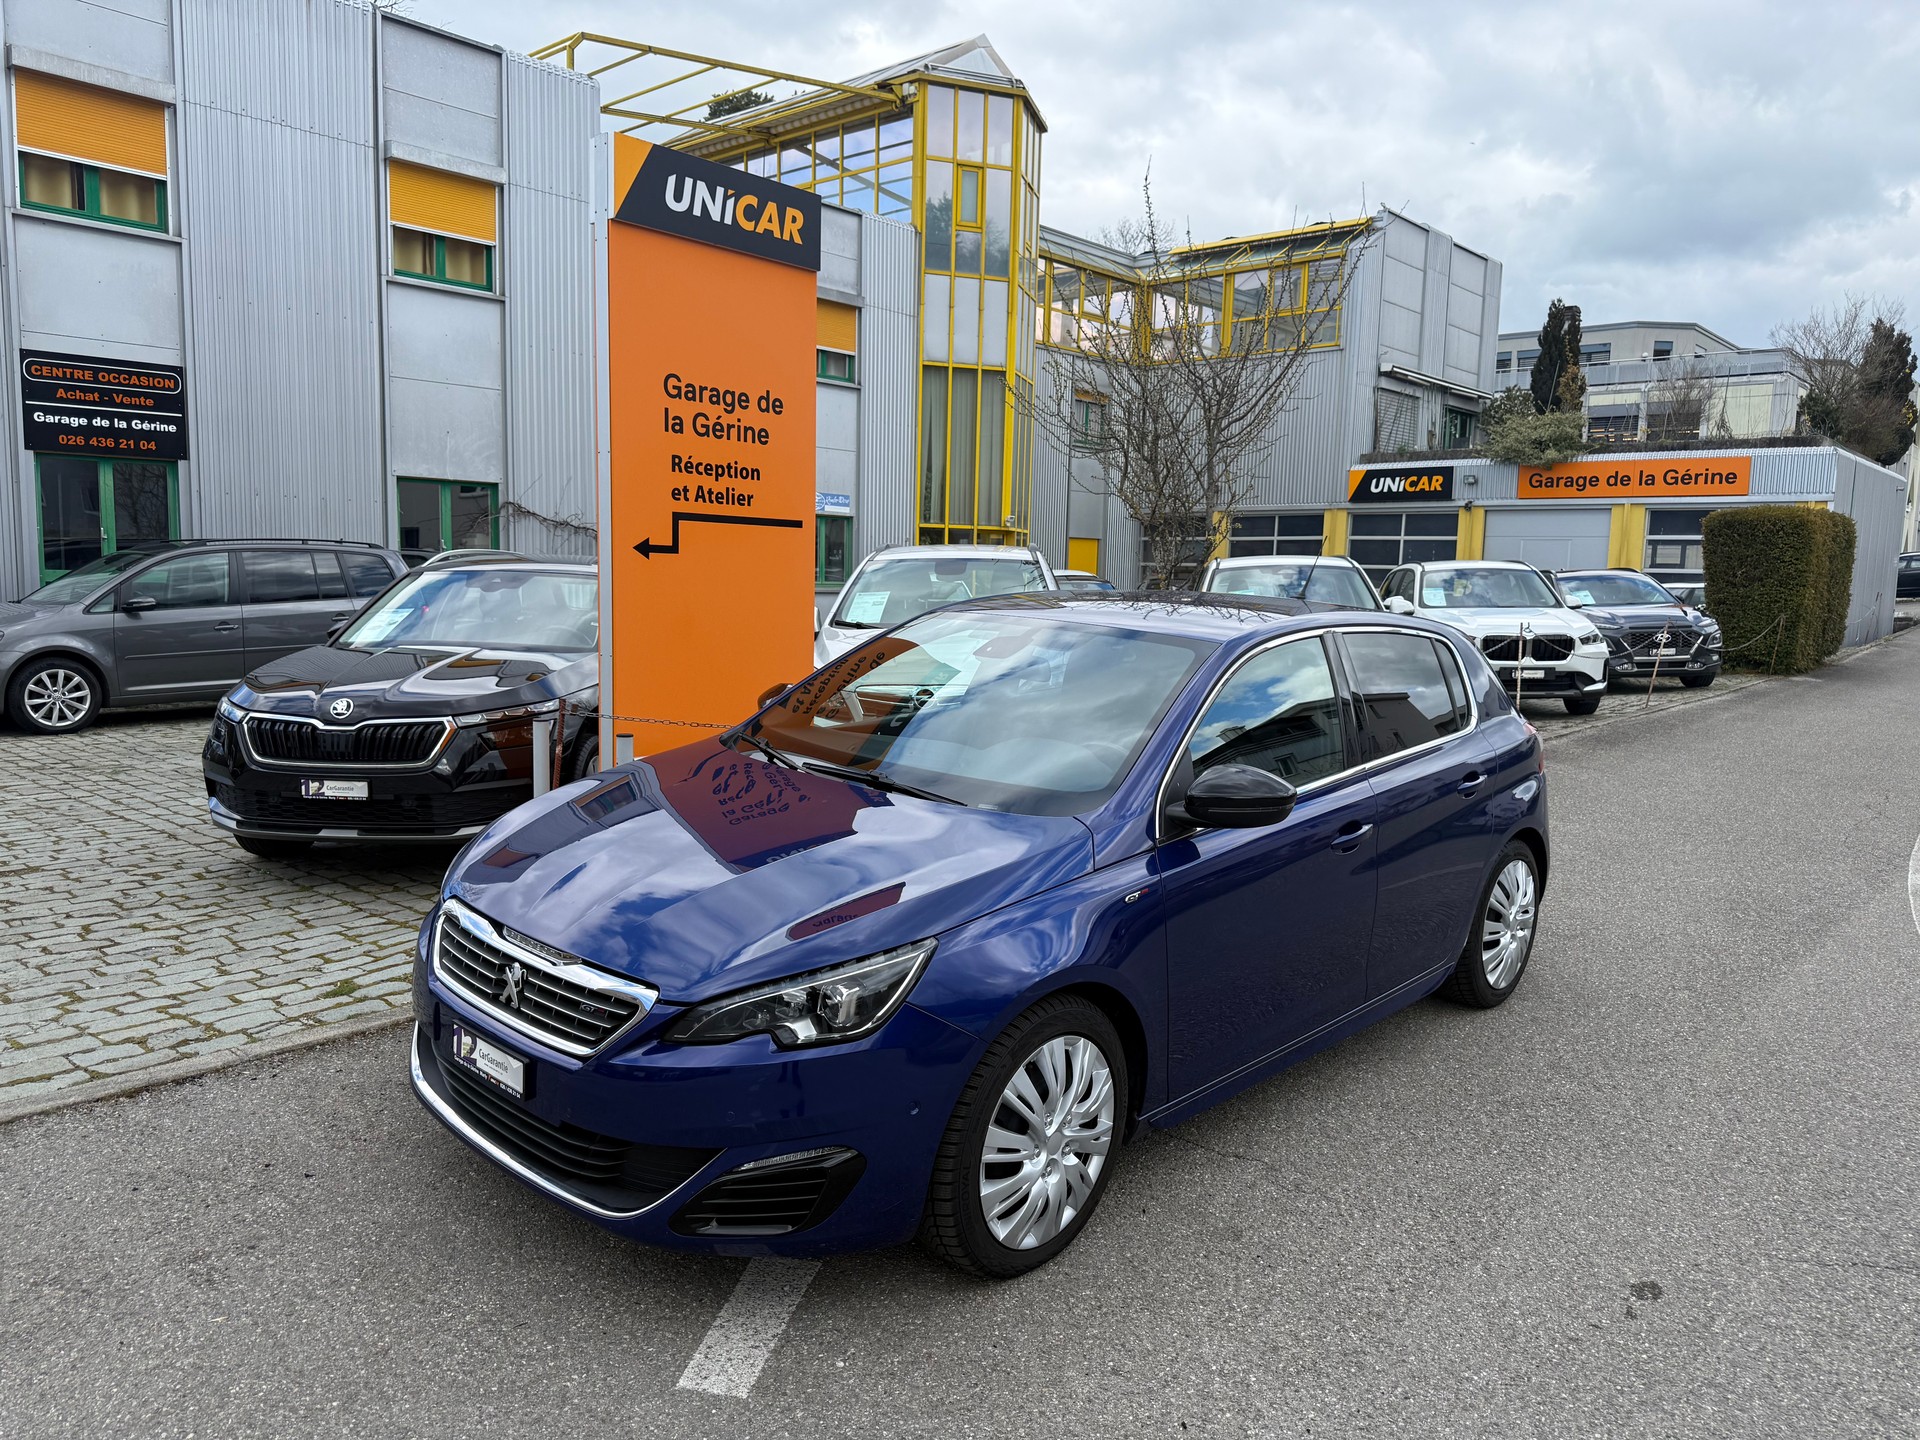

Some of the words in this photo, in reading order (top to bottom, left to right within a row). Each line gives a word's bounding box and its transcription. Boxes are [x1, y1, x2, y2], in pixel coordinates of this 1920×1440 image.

[30, 364, 94, 381] CENTRE
[98, 372, 175, 389] OCCASION
[56, 388, 100, 402] Achat
[112, 393, 154, 407] Vente
[663, 373, 750, 414] Garage
[757, 390, 784, 415] de
[33, 411, 88, 427] Garage
[92, 416, 110, 428] de
[114, 418, 127, 429] la
[131, 420, 177, 433] Gérine
[663, 407, 684, 435] la
[692, 412, 770, 445] Gérine
[58, 434, 85, 446] 026
[89, 436, 115, 448] 436
[119, 438, 135, 449] 21
[139, 440, 157, 451] 04
[671, 454, 761, 482] Réception
[1528, 472, 1600, 492] Garage
[1606, 471, 1632, 487] de
[1638, 470, 1656, 486] la
[1662, 468, 1738, 486] Gérine
[671, 485, 690, 502] et
[694, 485, 754, 507] Atelier
[478, 1048, 509, 1074] CarGarantie
